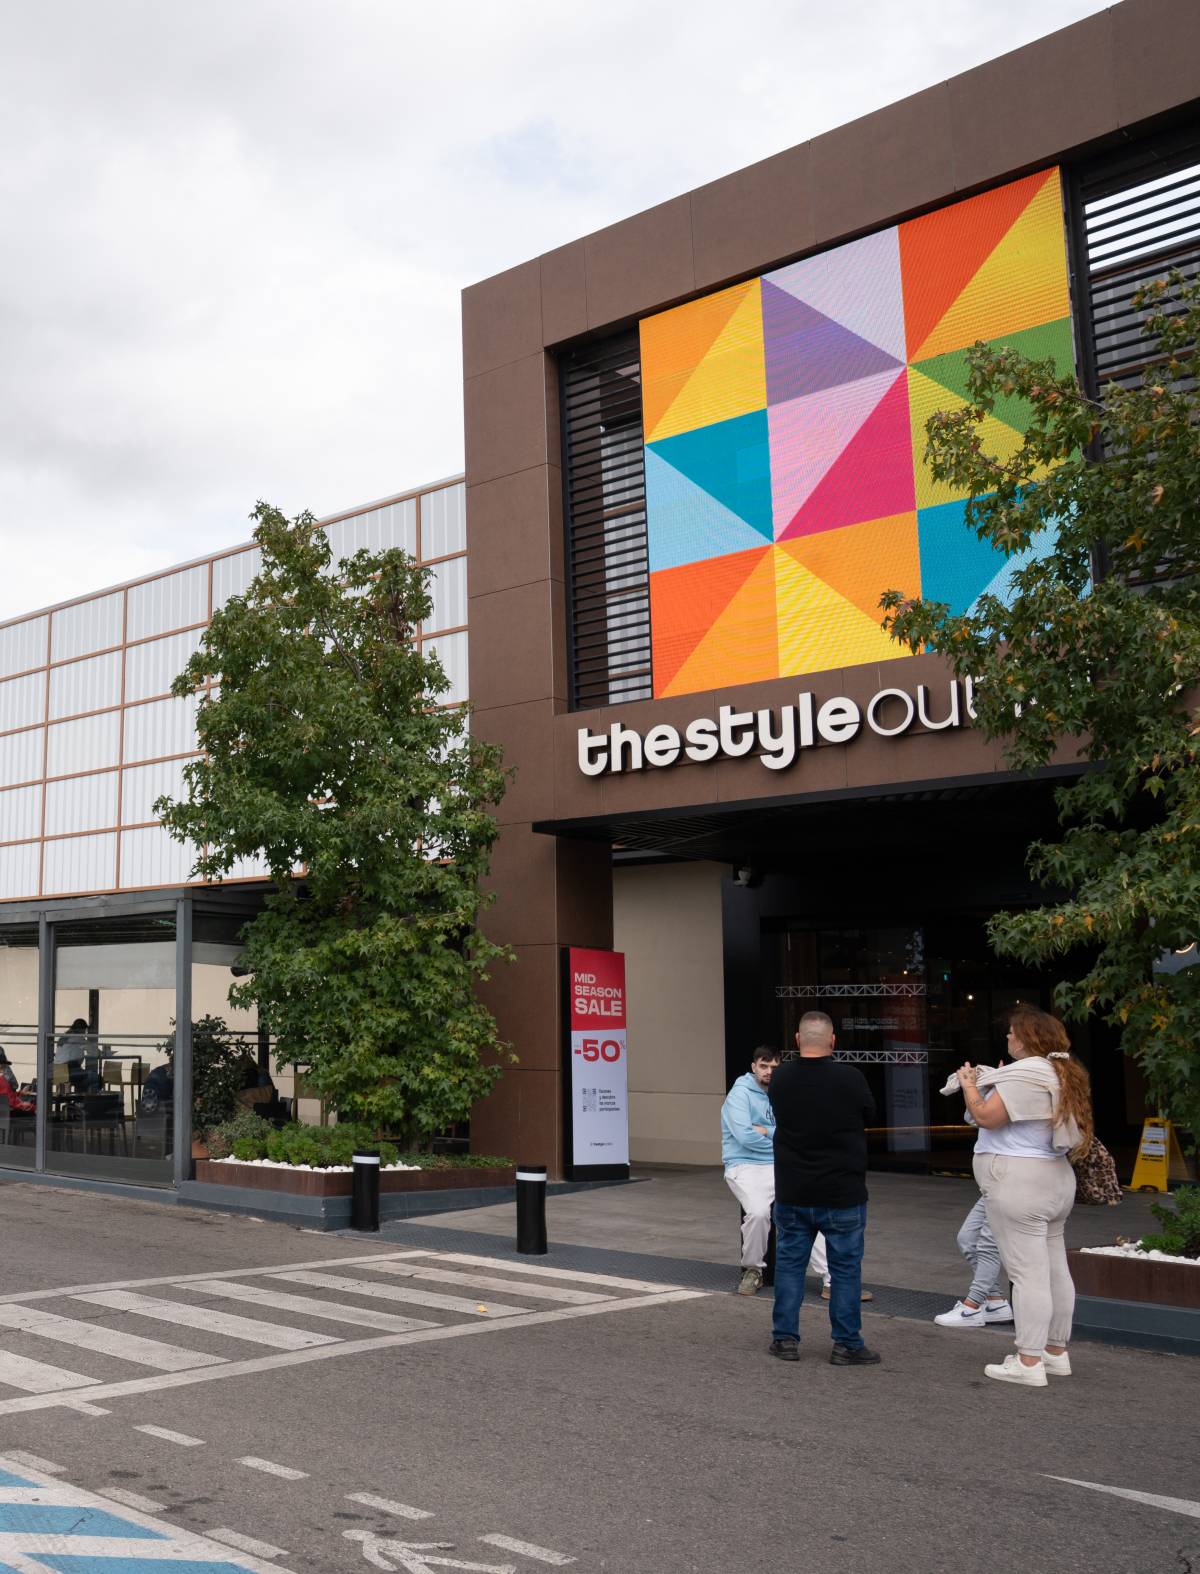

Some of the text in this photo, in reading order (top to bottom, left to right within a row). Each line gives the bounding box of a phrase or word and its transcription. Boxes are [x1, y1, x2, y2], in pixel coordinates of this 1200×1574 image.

[574, 972, 596, 984] MID
[574, 984, 622, 998] SEASON
[574, 998, 622, 1016] SALE
